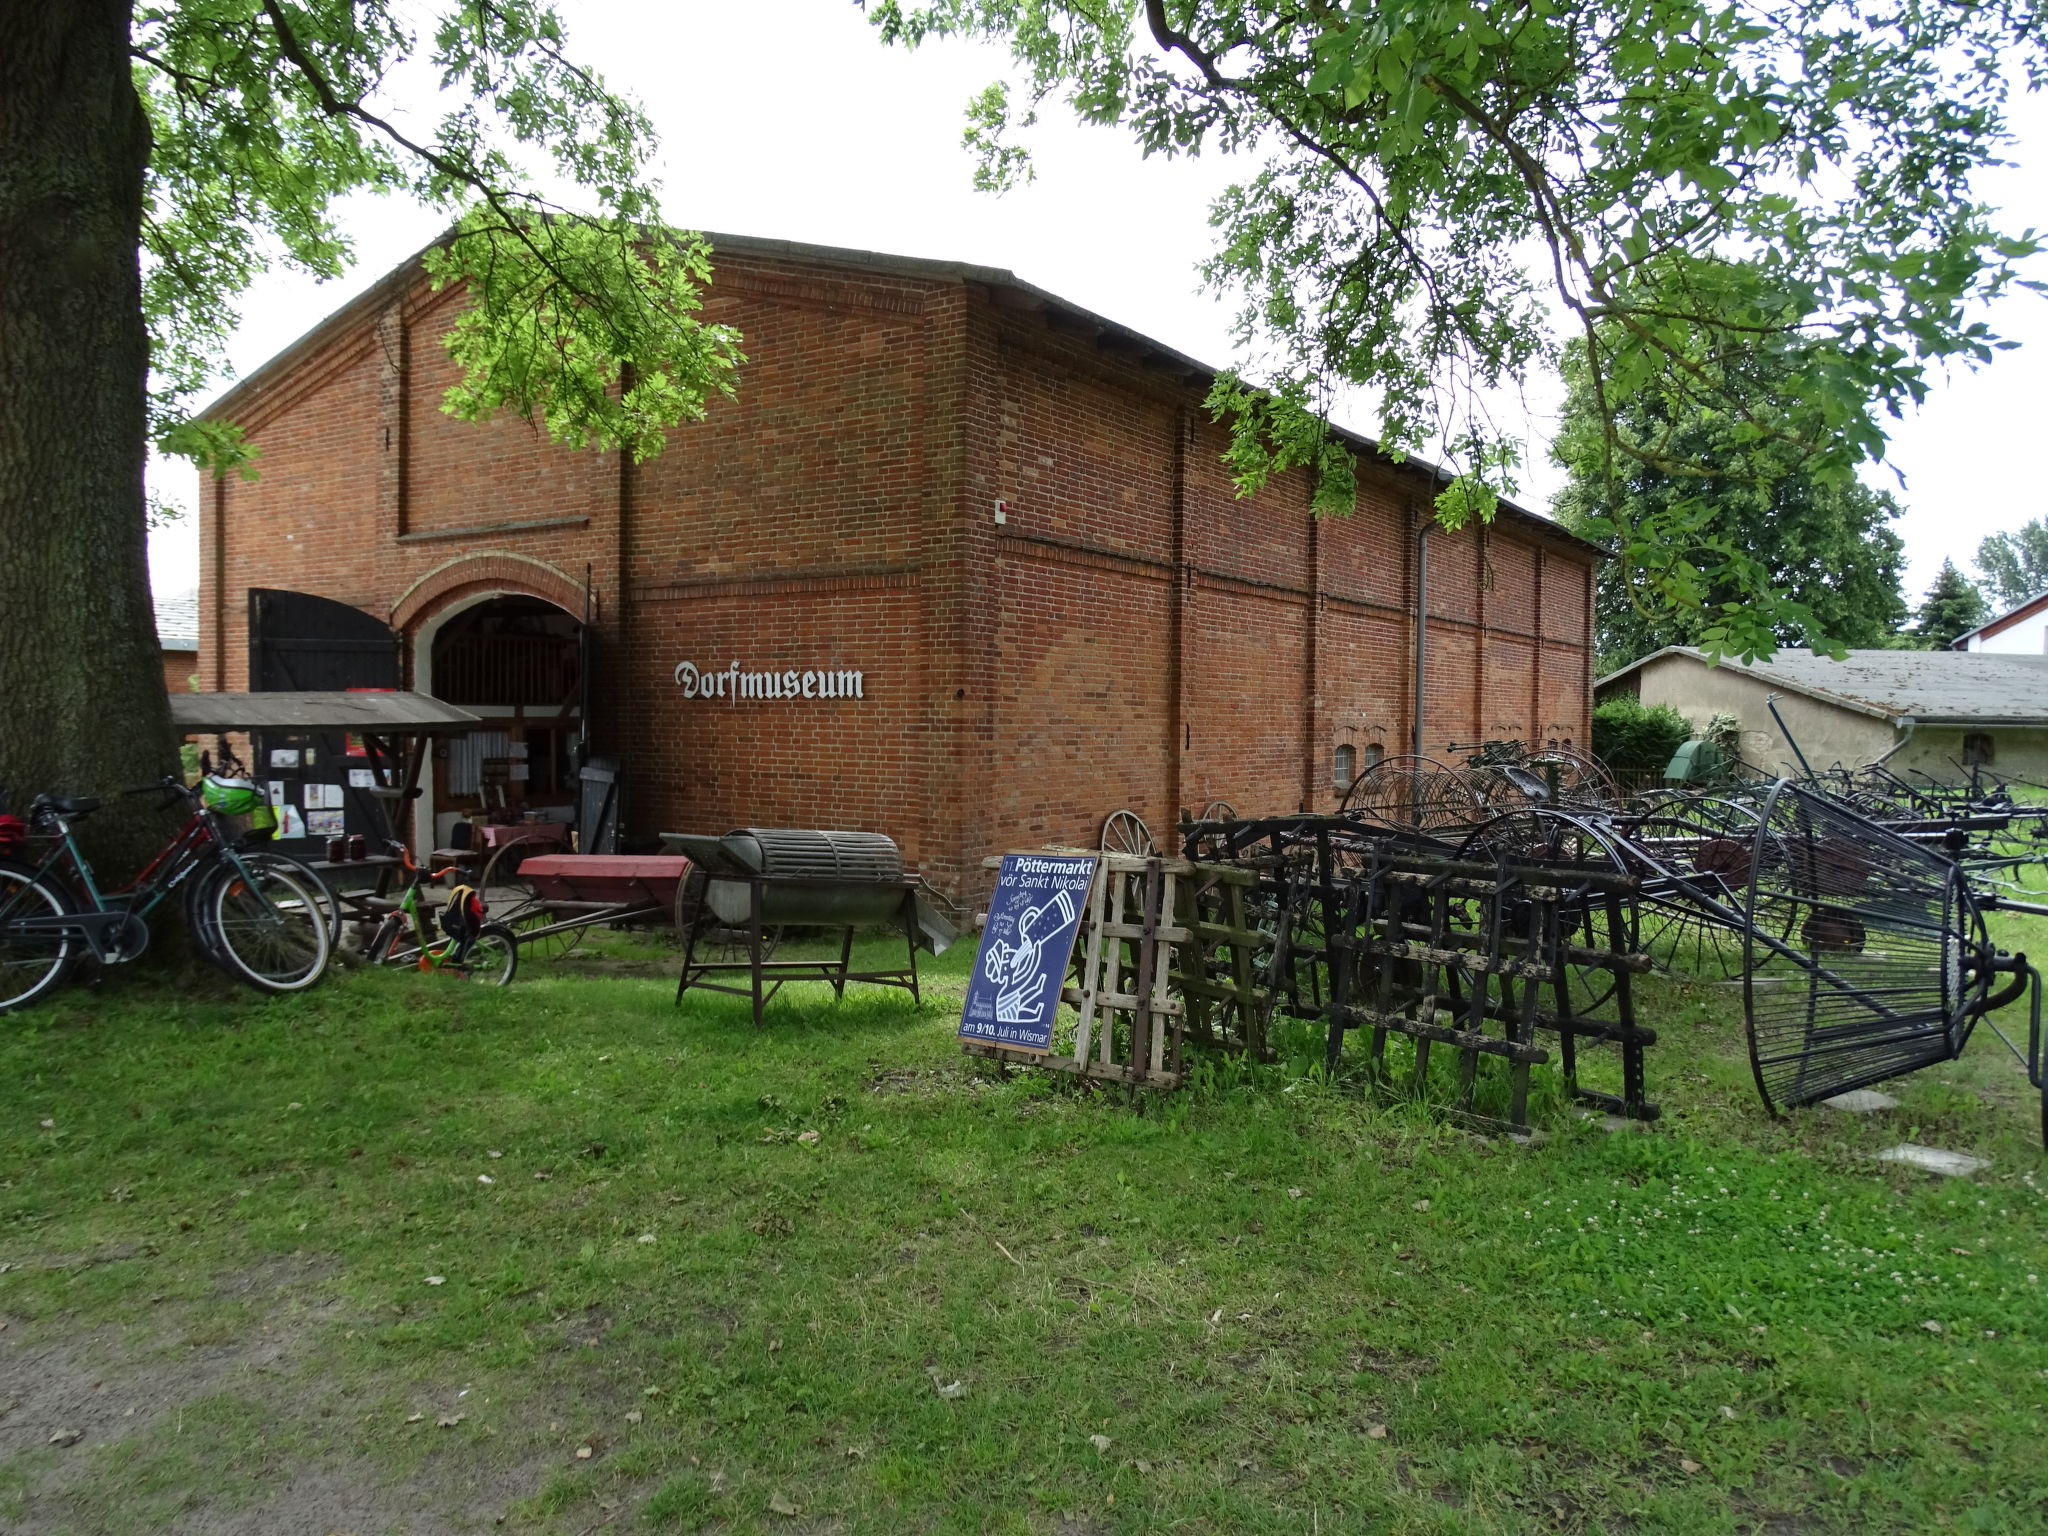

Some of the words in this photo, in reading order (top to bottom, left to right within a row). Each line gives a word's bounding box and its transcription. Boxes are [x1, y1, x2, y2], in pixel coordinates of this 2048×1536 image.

[675, 659, 864, 708] Dorfmuseum
[1015, 857, 1092, 875] Pöttermarkt
[1000, 874, 1017, 887] vör
[1019, 874, 1049, 889] Sankt
[1051, 875, 1088, 890] Nikolai
[963, 1023, 975, 1032] am
[976, 1022, 996, 1036] 9/10.
[997, 1026, 1010, 1038] Juli
[1010, 1027, 1017, 1039] in
[1019, 1028, 1047, 1043] Wismar
